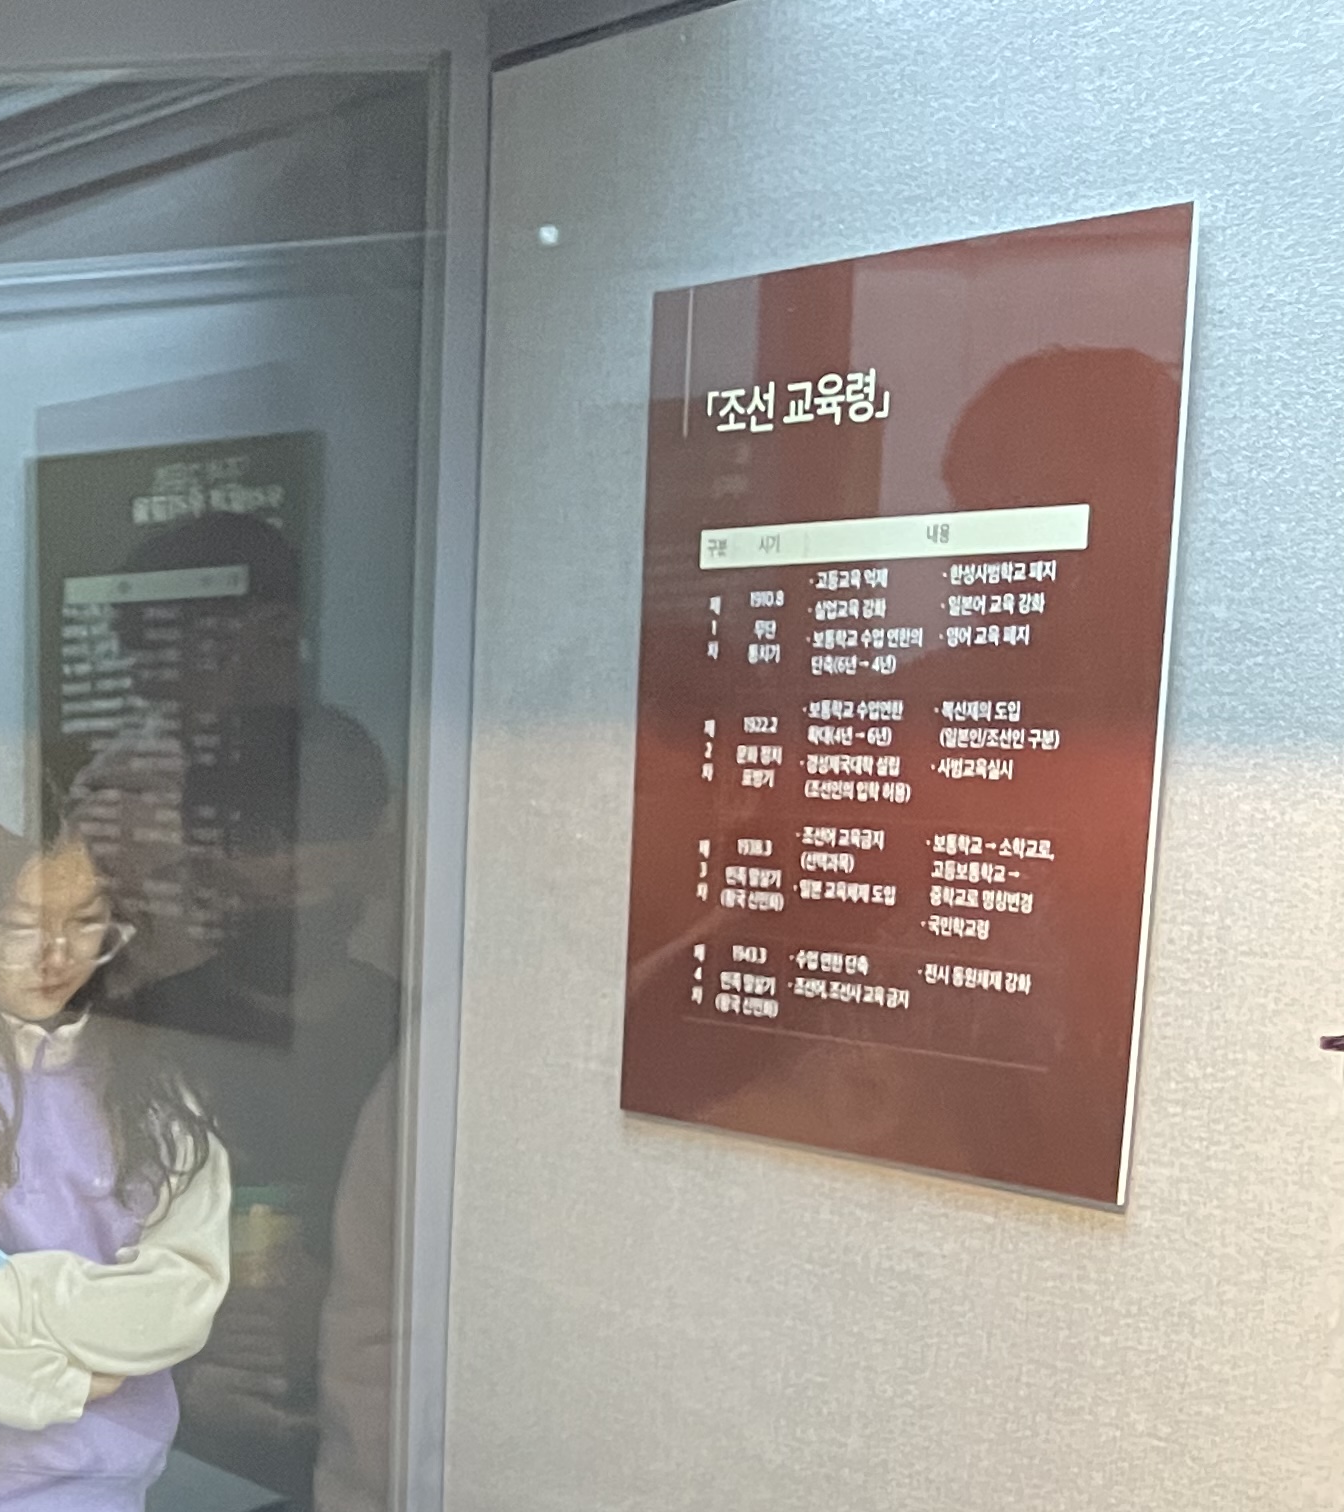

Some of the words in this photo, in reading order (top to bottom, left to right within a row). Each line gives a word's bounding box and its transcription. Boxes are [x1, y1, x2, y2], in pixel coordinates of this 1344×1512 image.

[707, 381, 775, 433] 「조선
[784, 369, 891, 426] 교육령」
[758, 534, 781, 555] 시기
[926, 523, 951, 544] 내용
[707, 537, 728, 558] 구분
[815, 571, 861, 590] 고등교육
[949, 594, 985, 616] 일본어
[989, 593, 1014, 614] 교육
[1018, 592, 1045, 613] 강화
[860, 629, 884, 649] 수업
[946, 627, 971, 647] 영어
[974, 625, 999, 645] 교육
[1003, 624, 1030, 645] 폐지
[994, 700, 1021, 722] 도입
[938, 758, 1013, 780] 사범교육실시
[932, 833, 983, 855] 보통학교
[931, 860, 1006, 884] 고등보통학교
